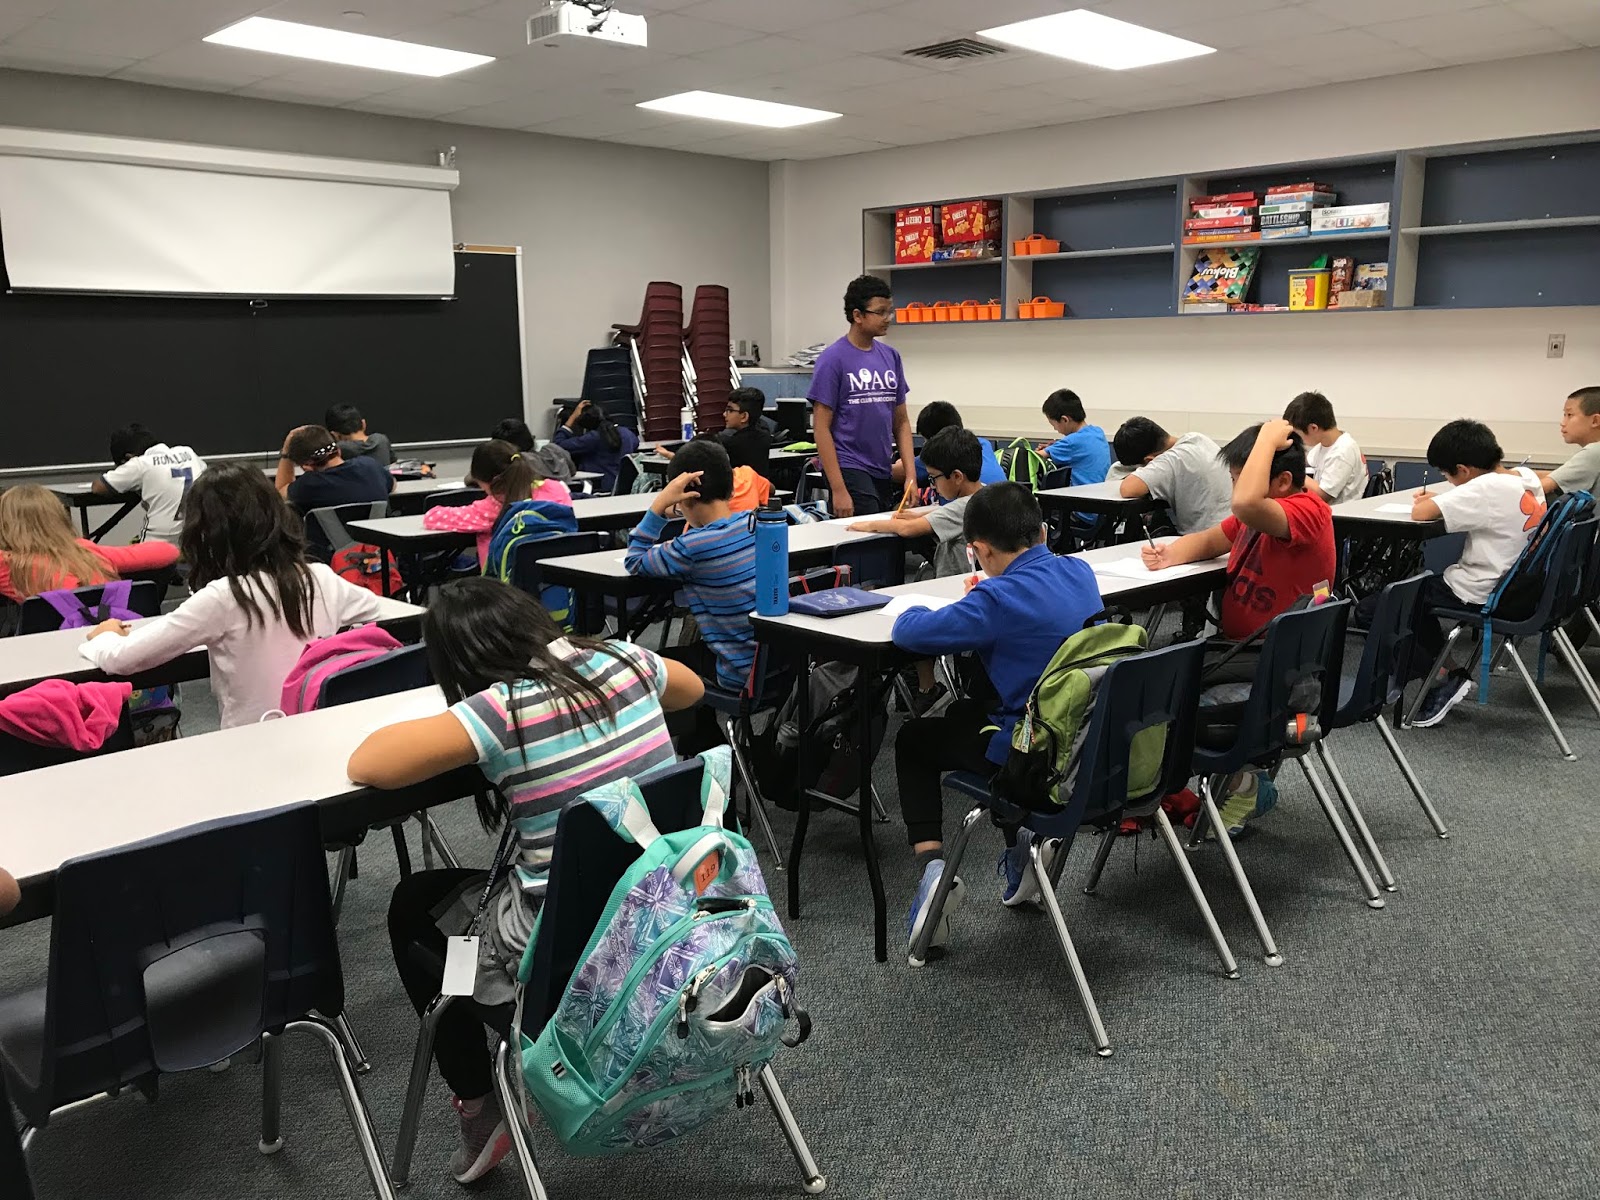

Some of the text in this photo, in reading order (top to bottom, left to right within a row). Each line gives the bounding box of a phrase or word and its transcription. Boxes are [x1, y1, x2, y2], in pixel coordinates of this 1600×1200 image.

[1260, 213, 1300, 226] BATTLESHIP
[1201, 267, 1240, 279] Blokus
[152, 451, 193, 466] RONLDO
[171, 467, 194, 521] 7
[701, 863, 716, 882] 119
